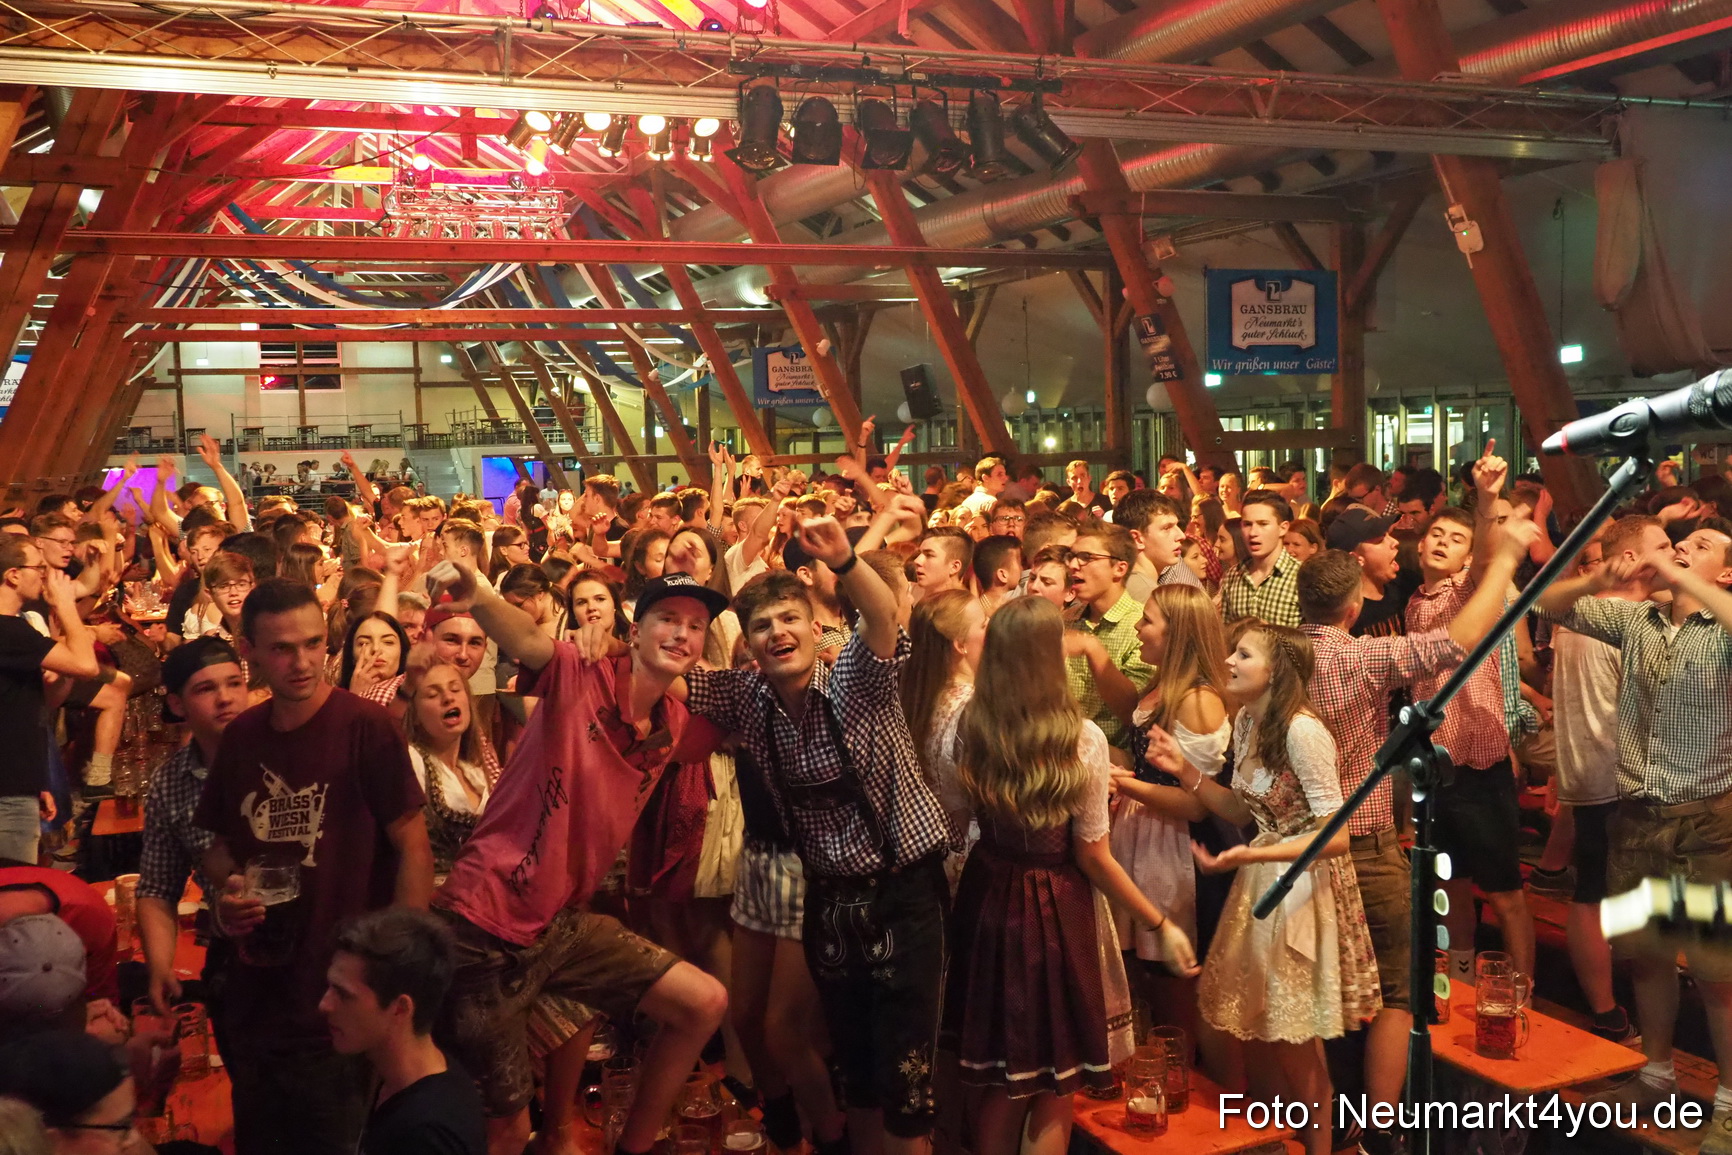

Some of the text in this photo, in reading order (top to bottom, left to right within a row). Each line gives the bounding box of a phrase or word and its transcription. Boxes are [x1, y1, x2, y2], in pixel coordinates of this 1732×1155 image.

[1240, 304, 1307, 315] GANSBRÄU
[1244, 316, 1303, 329] Neumarkt's
[1241, 331, 1266, 341] guter
[771, 365, 813, 373] GANSBRÄ
[1212, 359, 1232, 370] Wir
[1234, 356, 1270, 375] grüßen
[1306, 358, 1335, 369] Gäste!
[770, 396, 793, 407] grüßen
[269, 794, 311, 814] BRASS
[269, 810, 310, 829] WIESN
[267, 825, 311, 840] FESTIVAL
